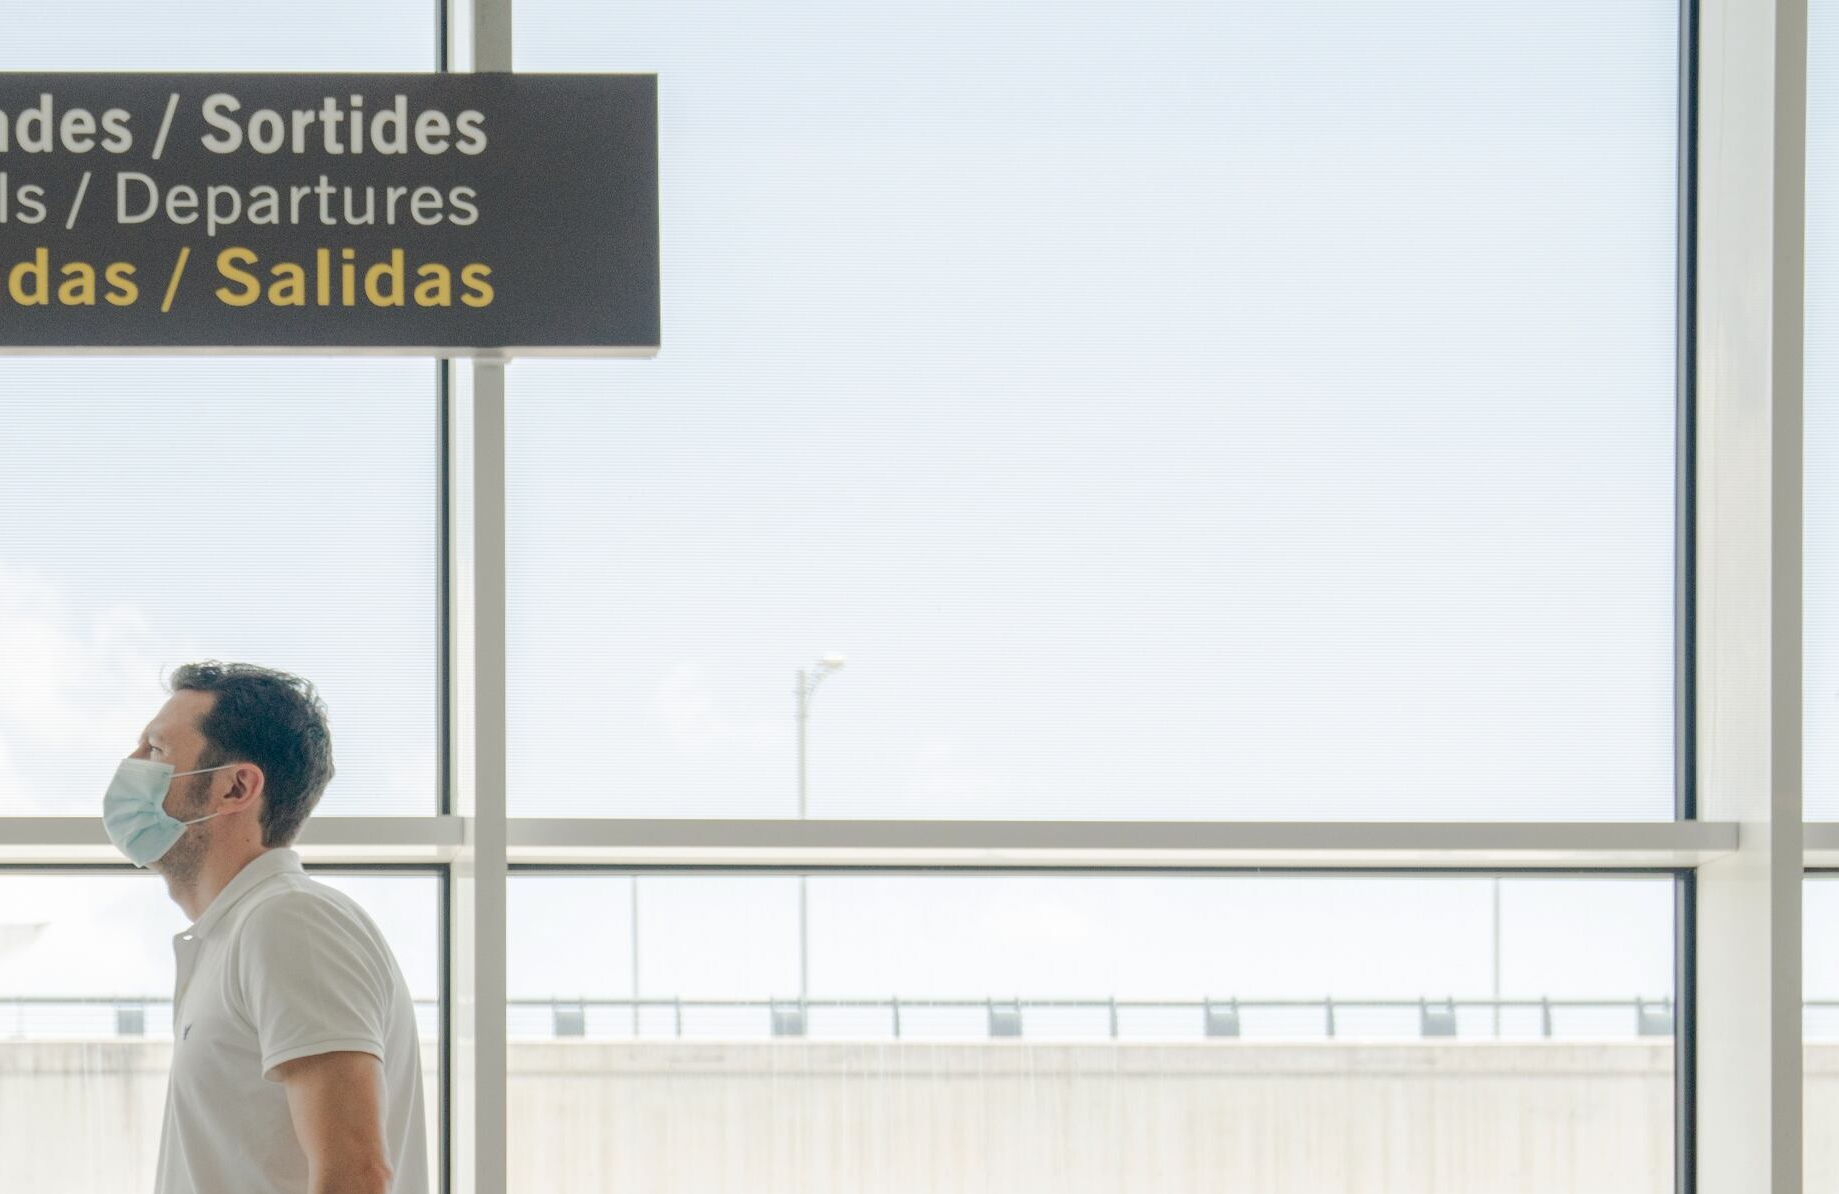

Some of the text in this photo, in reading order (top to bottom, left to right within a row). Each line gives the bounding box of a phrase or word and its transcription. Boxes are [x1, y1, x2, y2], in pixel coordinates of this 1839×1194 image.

[151, 92, 180, 160] /
[200, 92, 487, 155] Sortides
[65, 171, 91, 230] /
[117, 172, 479, 237] Departures
[161, 247, 190, 313] /
[215, 246, 494, 308] Salidas
